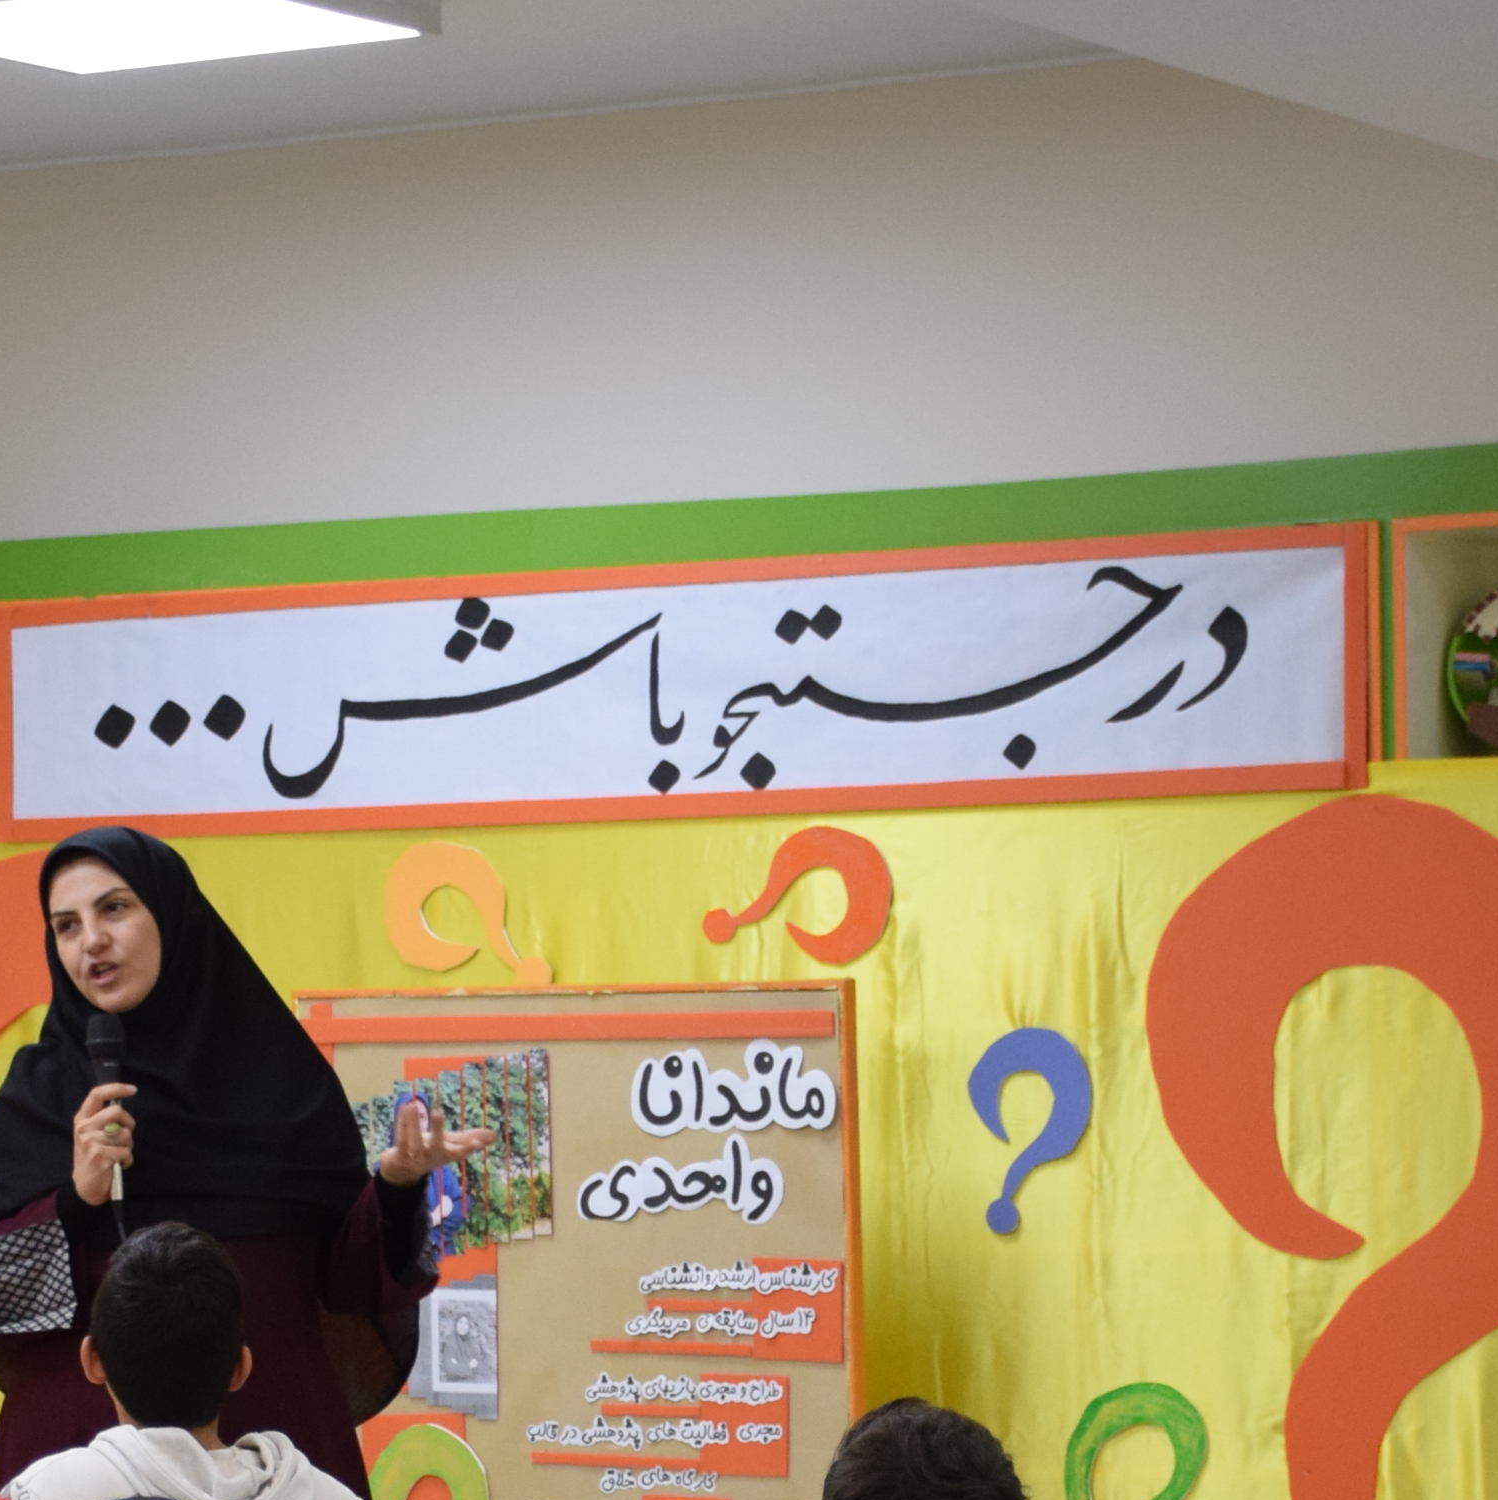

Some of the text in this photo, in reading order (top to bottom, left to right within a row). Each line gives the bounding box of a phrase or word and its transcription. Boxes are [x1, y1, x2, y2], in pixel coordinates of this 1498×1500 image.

[693, 565, 1185, 790] جستجو
[1109, 604, 1248, 723] در
[639, 1051, 825, 1126] ماندانا
[580, 1140, 773, 1221] واحدی
[758, 1263, 836, 1292] کارشناس
[761, 1310, 794, 1335] سال
[586, 1374, 641, 1403] پژوهشی
[700, 1383, 737, 1400] مجری
[740, 1385, 747, 1398] و
[750, 1380, 781, 1401] طراح
[527, 1417, 782, 1449] مجری فعالیت های پژوهشی در قالب
[601, 1470, 636, 1492] خلاق
